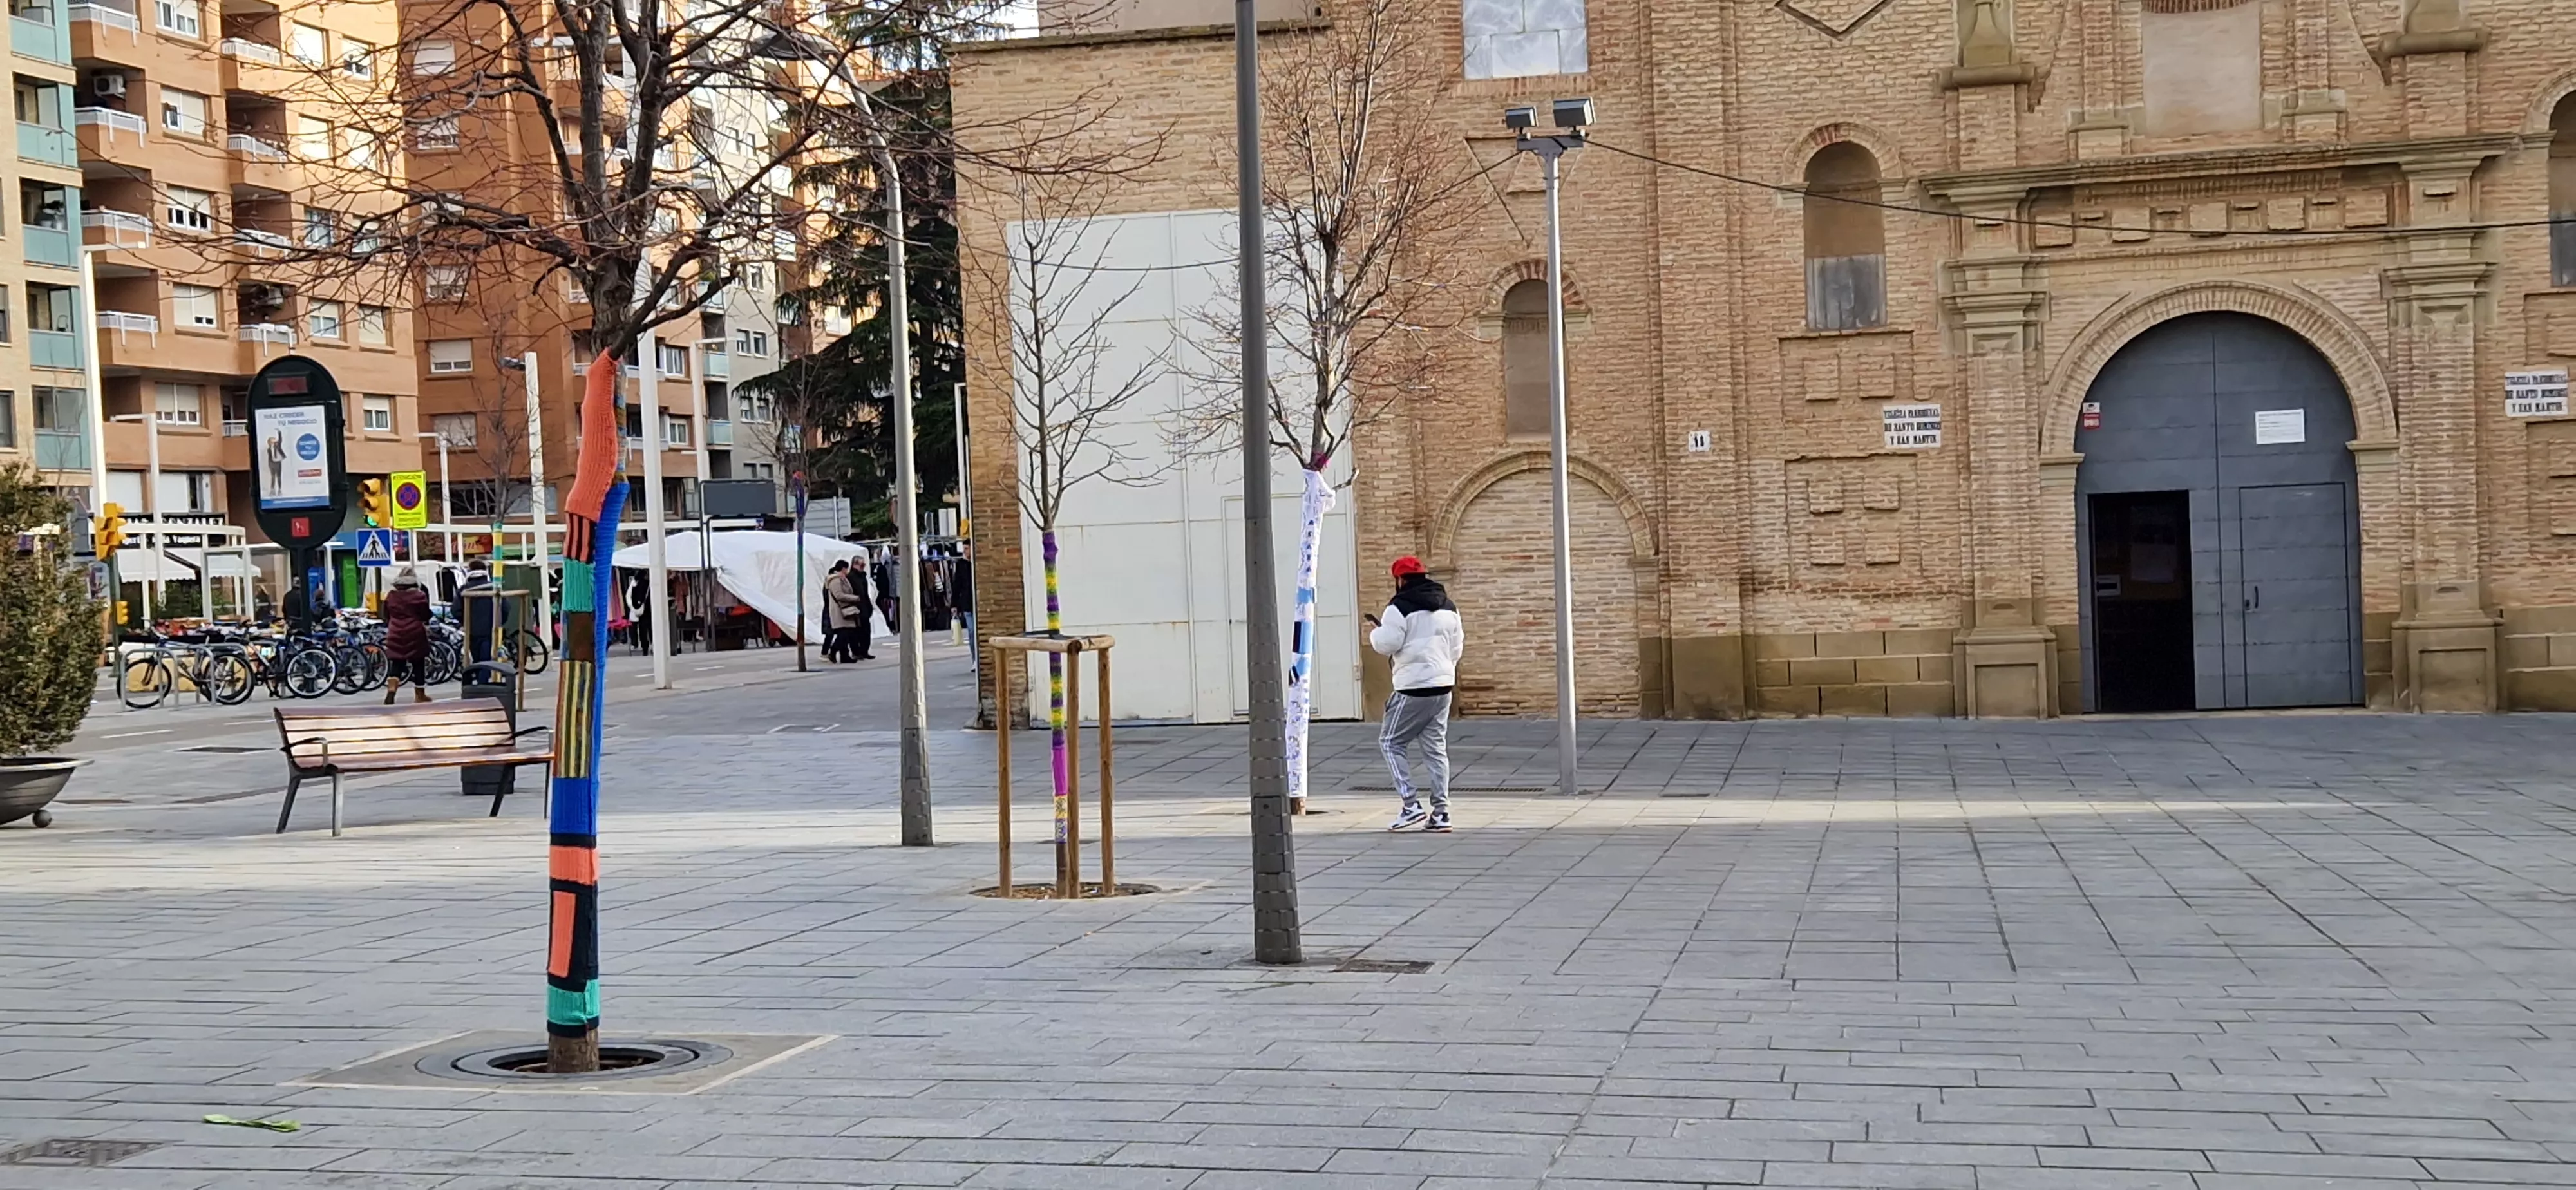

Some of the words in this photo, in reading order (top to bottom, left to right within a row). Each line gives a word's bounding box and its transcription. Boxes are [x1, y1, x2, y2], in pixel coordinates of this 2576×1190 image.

[1894, 422, 1914, 431] SANTO
[1890, 436, 1893, 444] Y
[1897, 435, 1909, 444] SAN
